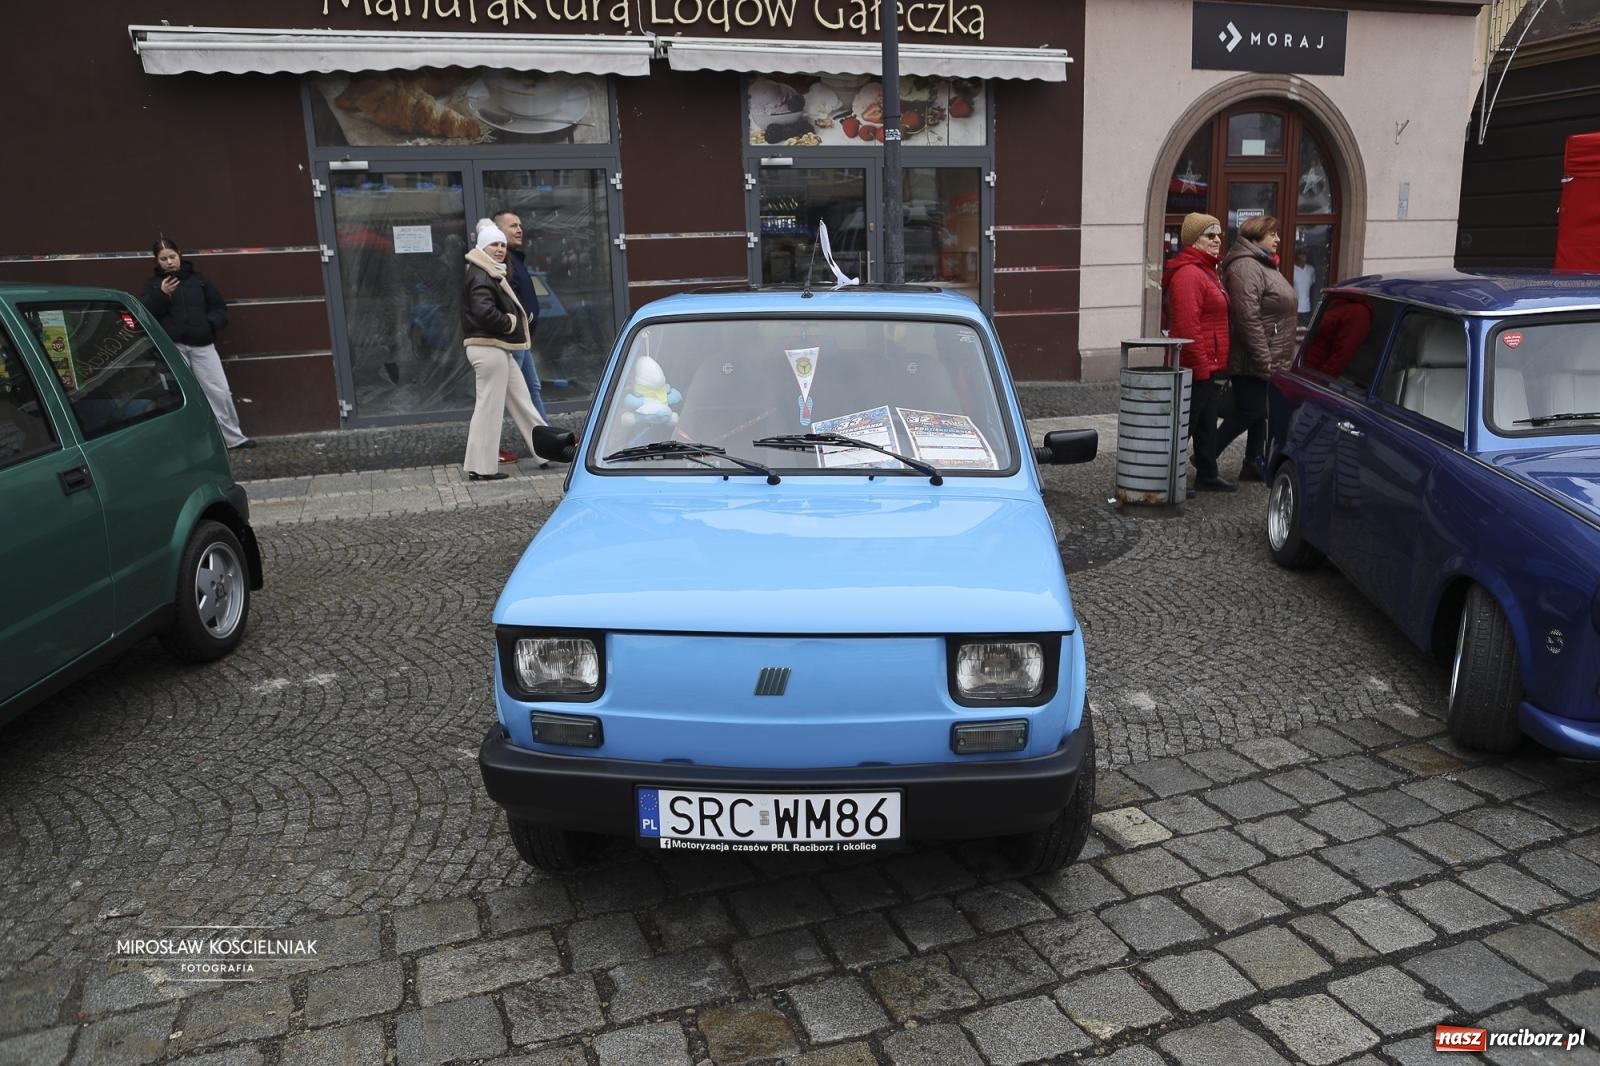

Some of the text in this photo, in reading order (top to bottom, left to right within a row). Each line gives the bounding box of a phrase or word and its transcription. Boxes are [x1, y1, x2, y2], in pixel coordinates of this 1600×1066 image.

[1251, 32, 1325, 49] MORAJ
[642, 819, 658, 830] PL
[669, 796, 888, 839] SRC WM86
[672, 840, 729, 852] Motoryzacja
[732, 843, 768, 852] czasów
[771, 843, 790, 852] PRL
[793, 843, 834, 852] Raciborz
[843, 841, 877, 851] okolice
